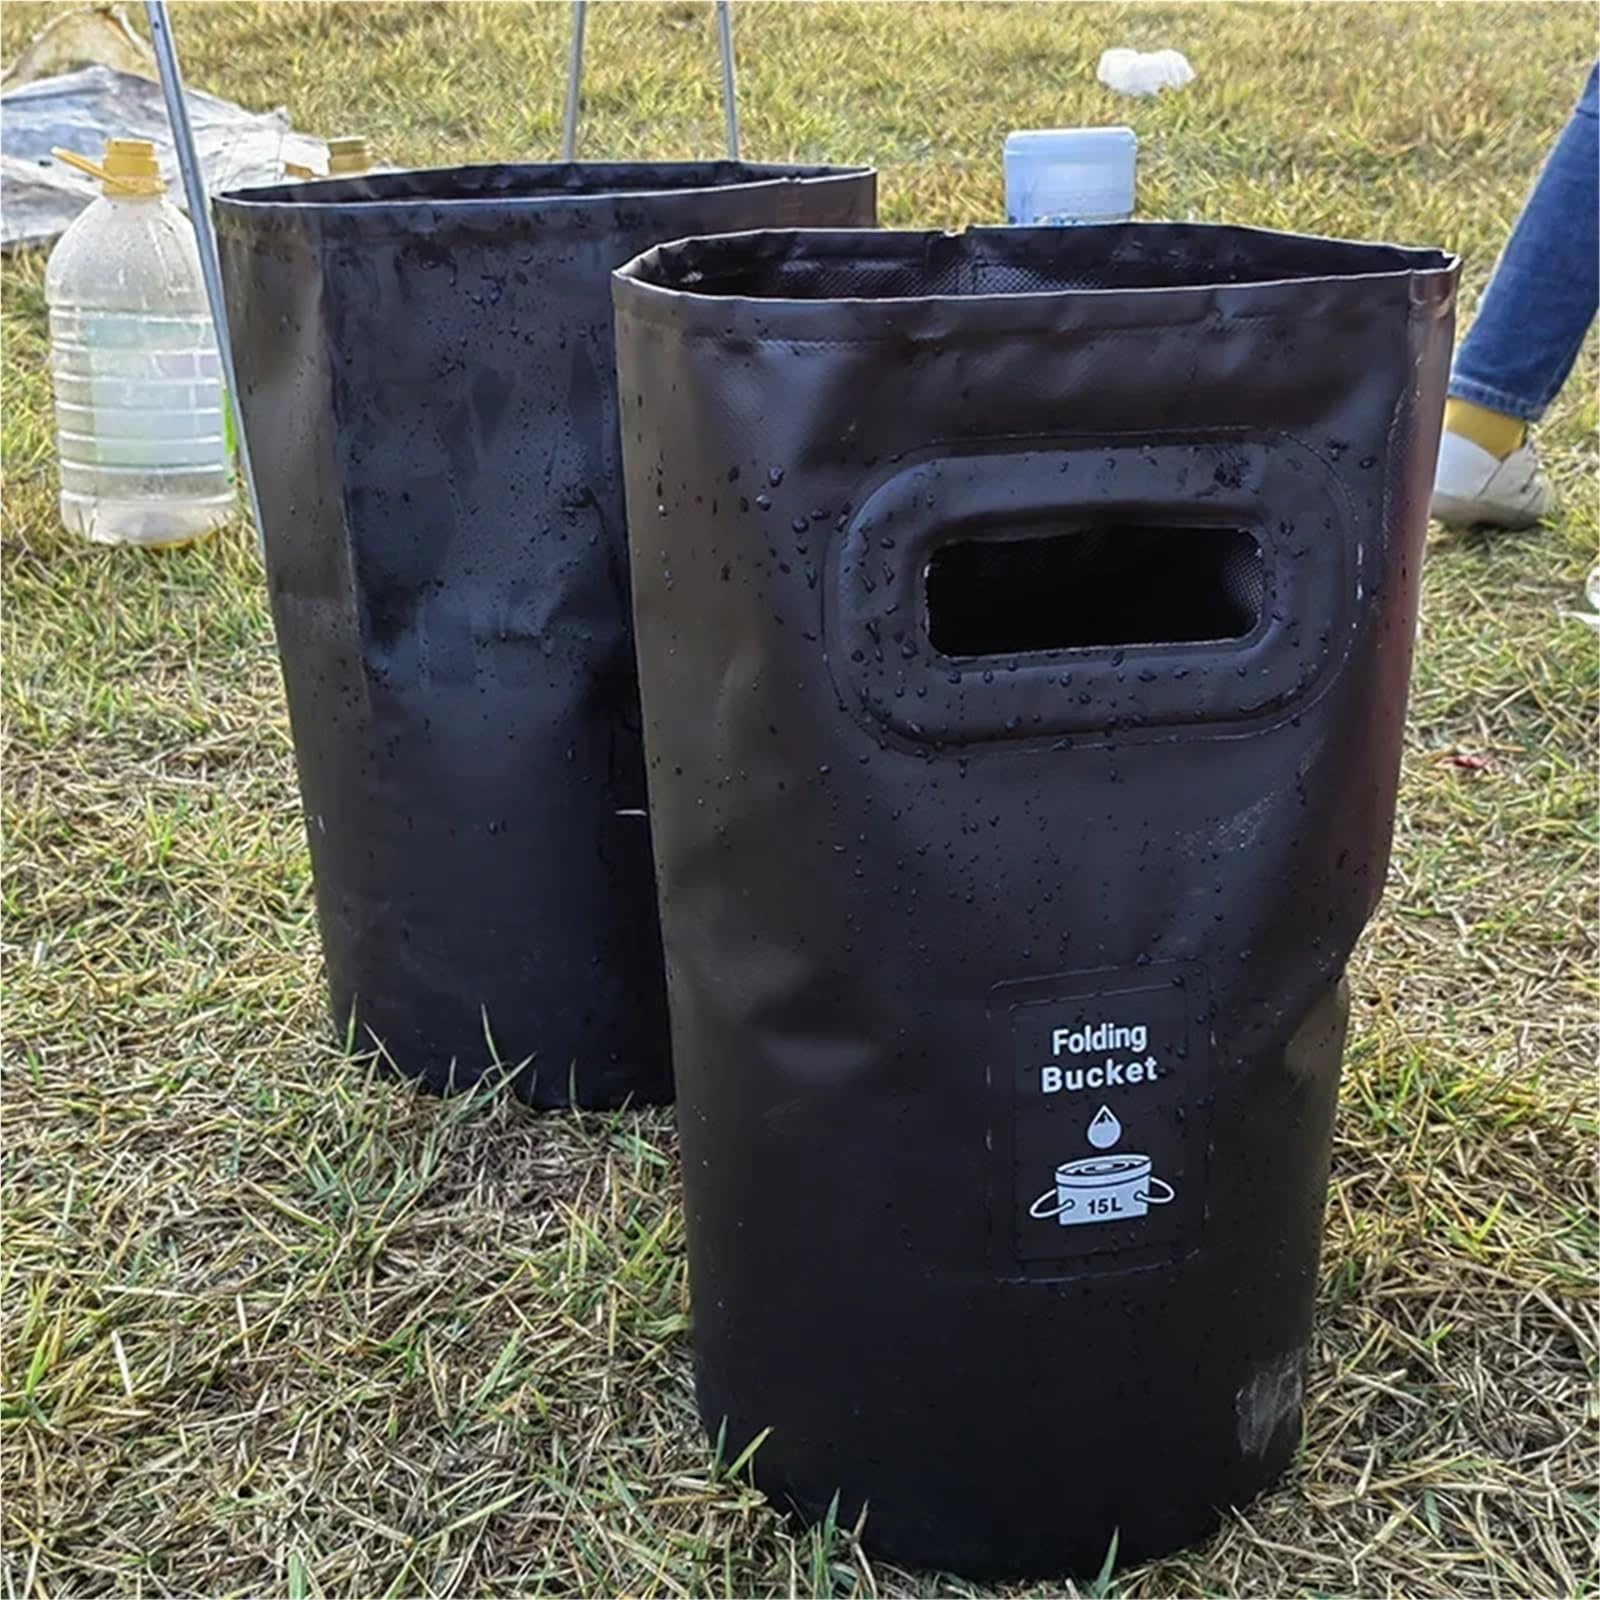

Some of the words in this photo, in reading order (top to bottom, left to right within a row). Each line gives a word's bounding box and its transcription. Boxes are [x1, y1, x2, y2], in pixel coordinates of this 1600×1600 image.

[1052, 1023, 1148, 1056] Folding
[1041, 1056, 1158, 1093] Bucket
[1087, 1197, 1123, 1215] 15L
